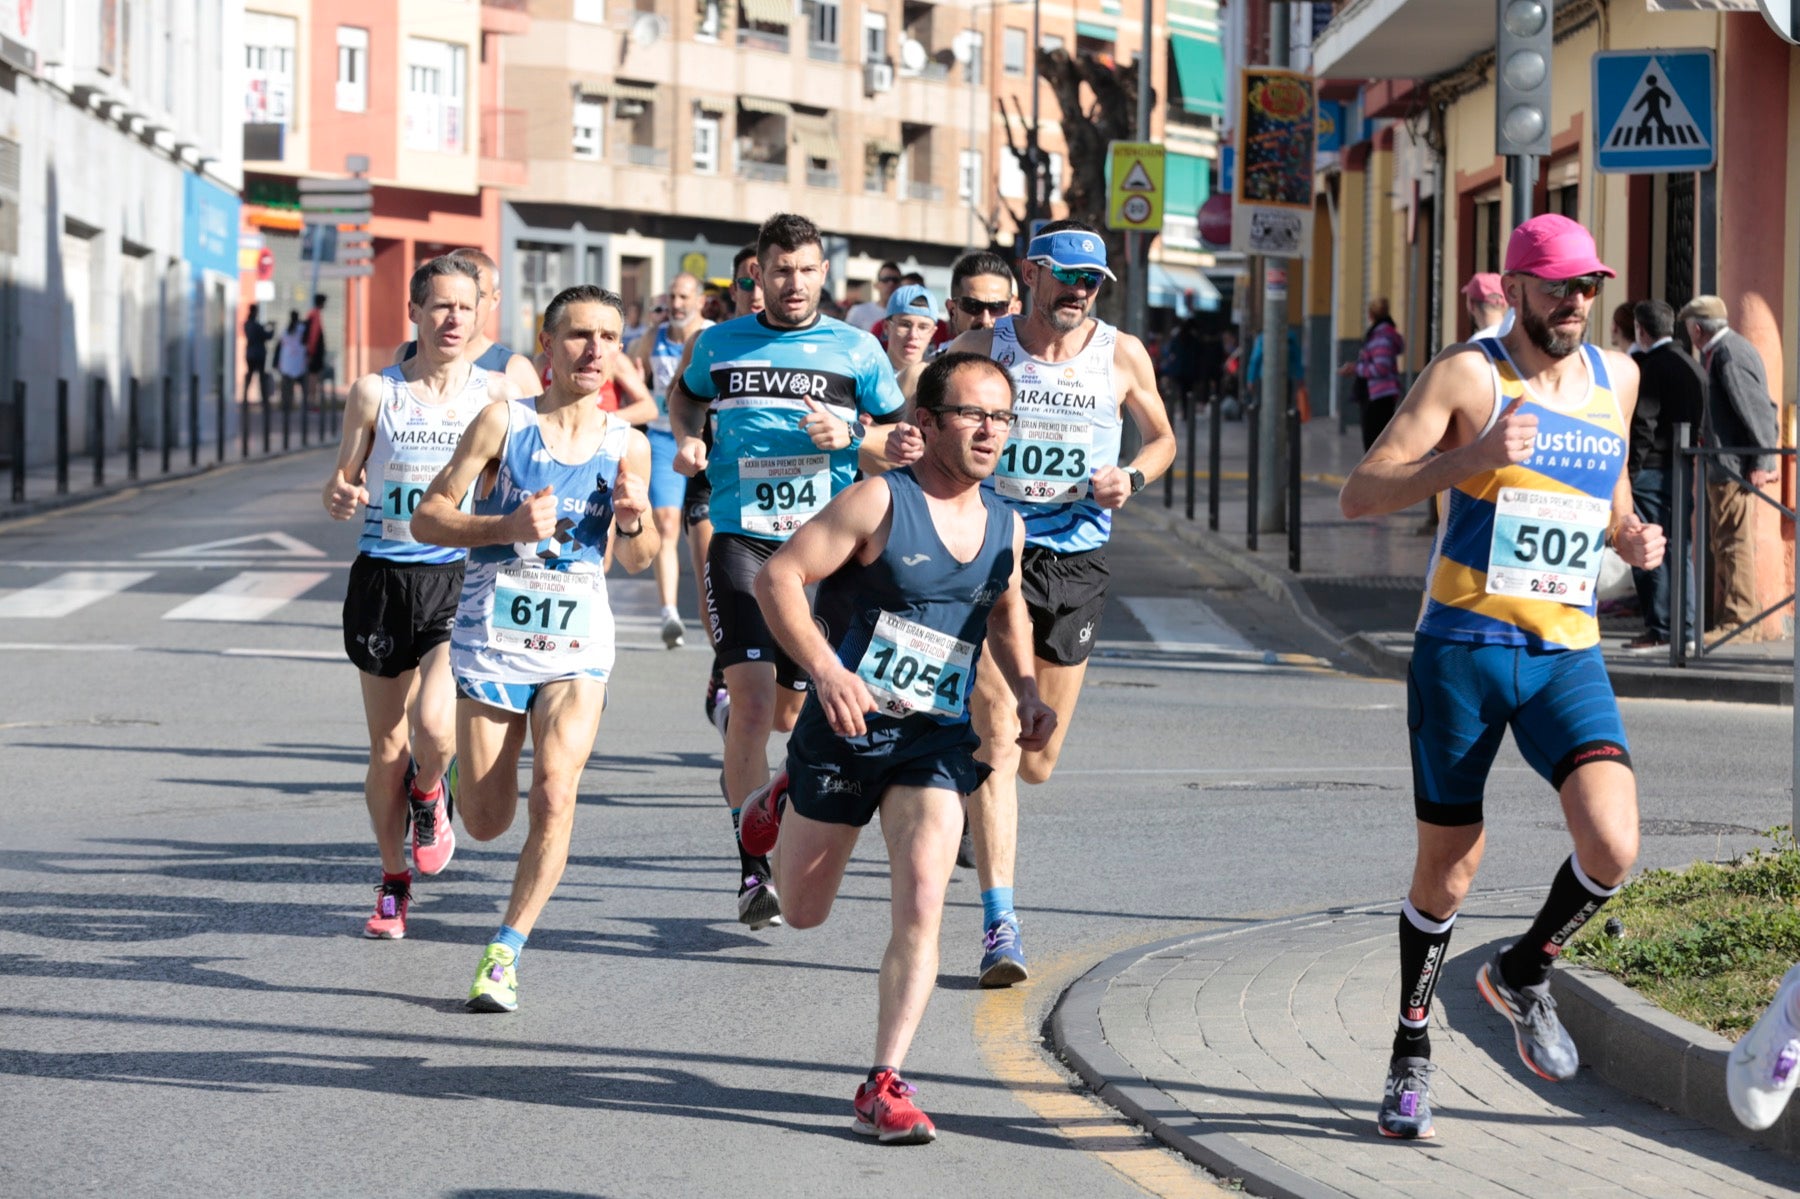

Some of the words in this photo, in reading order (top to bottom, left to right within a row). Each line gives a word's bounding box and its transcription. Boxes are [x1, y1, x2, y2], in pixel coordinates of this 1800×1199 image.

[729, 371, 828, 398] BEWOR
[1016, 389, 1096, 410] ARACENA
[1021, 420, 1037, 429] GRAN
[1038, 422, 1060, 432] PREMIO
[1532, 430, 1621, 456] ustinos
[806, 456, 824, 465] FONDO
[1002, 443, 1086, 478] 1023
[756, 480, 816, 511] 994
[1513, 525, 1589, 569] 502
[522, 570, 539, 579] GRAN
[540, 573, 562, 582] PREMIO
[563, 575, 571, 583] DE
[510, 595, 578, 630] 617
[906, 624, 924, 638] GRAN
[874, 647, 960, 706] 1054
